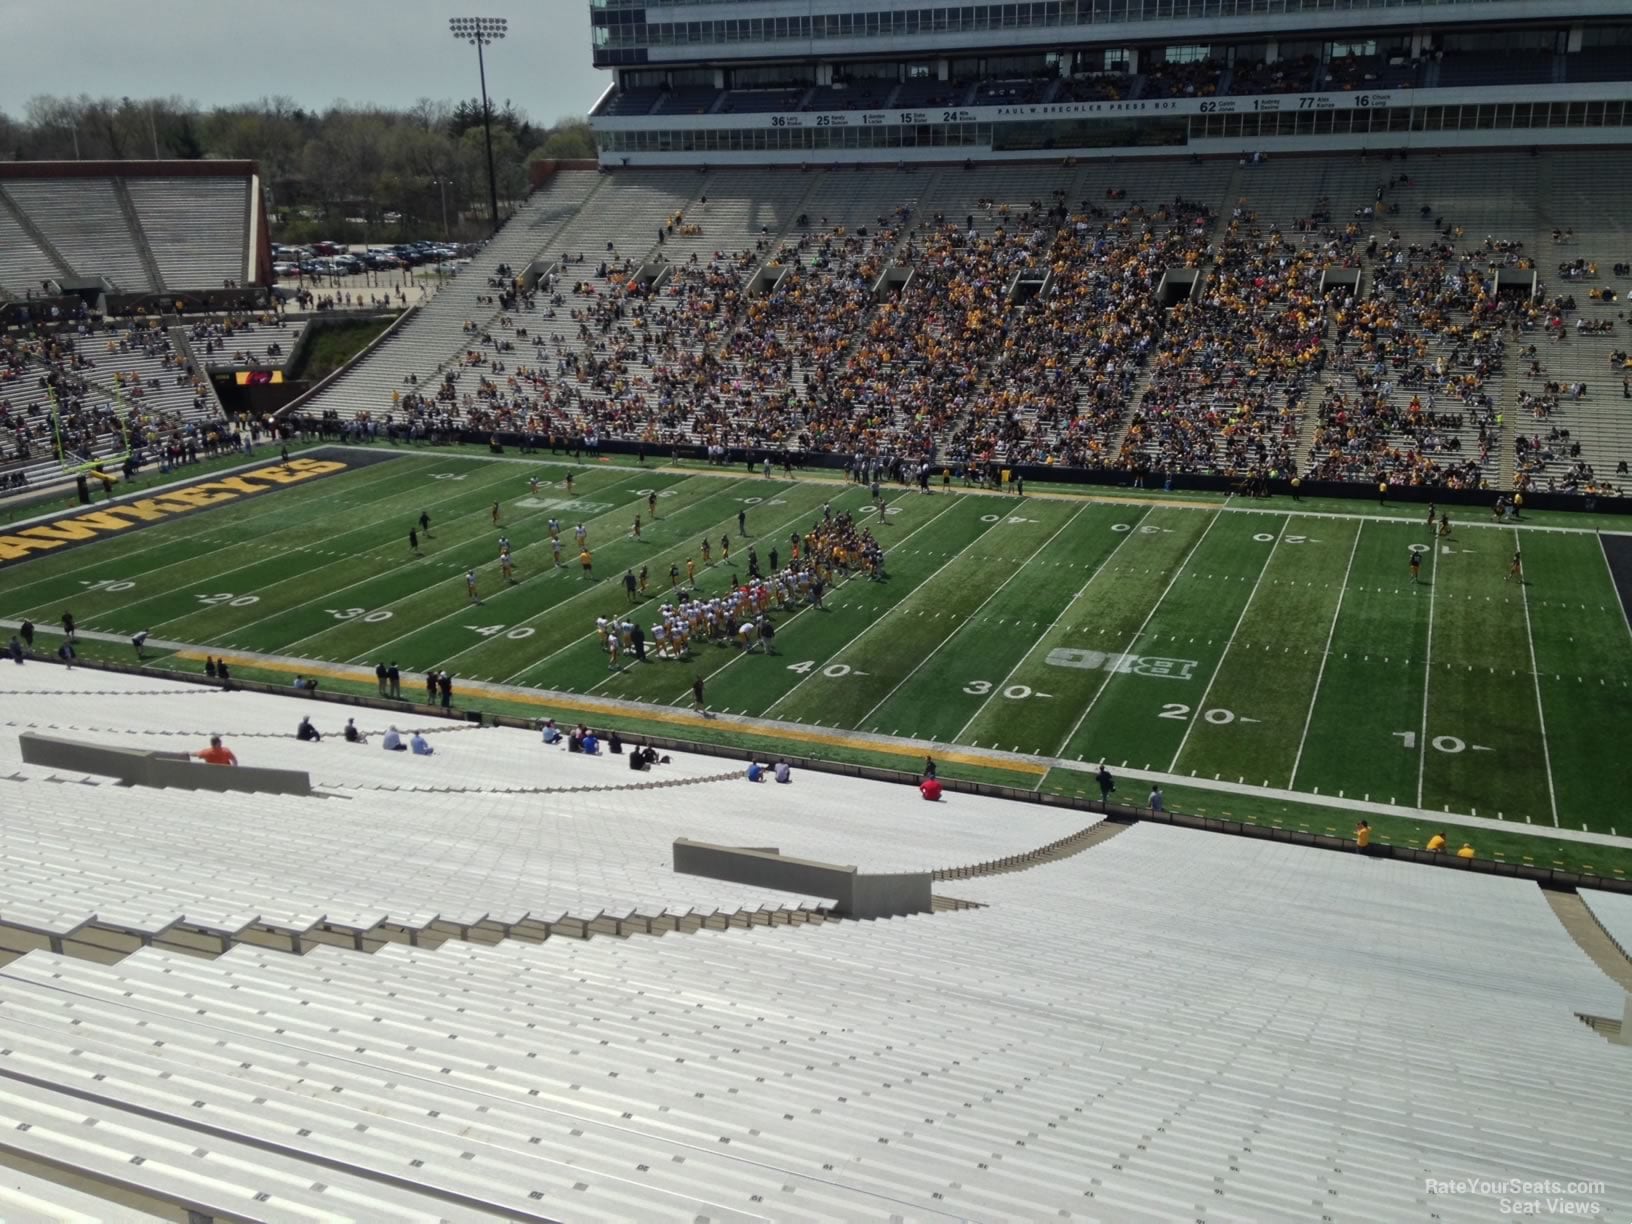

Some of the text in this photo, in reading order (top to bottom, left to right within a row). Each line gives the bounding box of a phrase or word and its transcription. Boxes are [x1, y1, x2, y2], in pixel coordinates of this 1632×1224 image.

[1200, 101, 1217, 113] 62
[1254, 99, 1259, 111] 1
[1299, 97, 1315, 108] 77
[1355, 95, 1369, 107] 16
[1043, 105, 1102, 113] BRECHLER
[771, 117, 786, 127] 36
[817, 116, 830, 126] 25
[862, 114, 867, 124] 1
[900, 113, 912, 123] 15
[943, 112, 958, 122] 24
[0, 458, 348, 561] AWKEYES
[88, 580, 136, 593] 10
[206, 592, 261, 608] 20
[333, 607, 394, 623] 30
[475, 624, 536, 640] 40
[786, 660, 852, 678] 40
[962, 680, 1032, 700] 30
[1158, 703, 1235, 725] 20
[1392, 730, 1467, 754] 10
